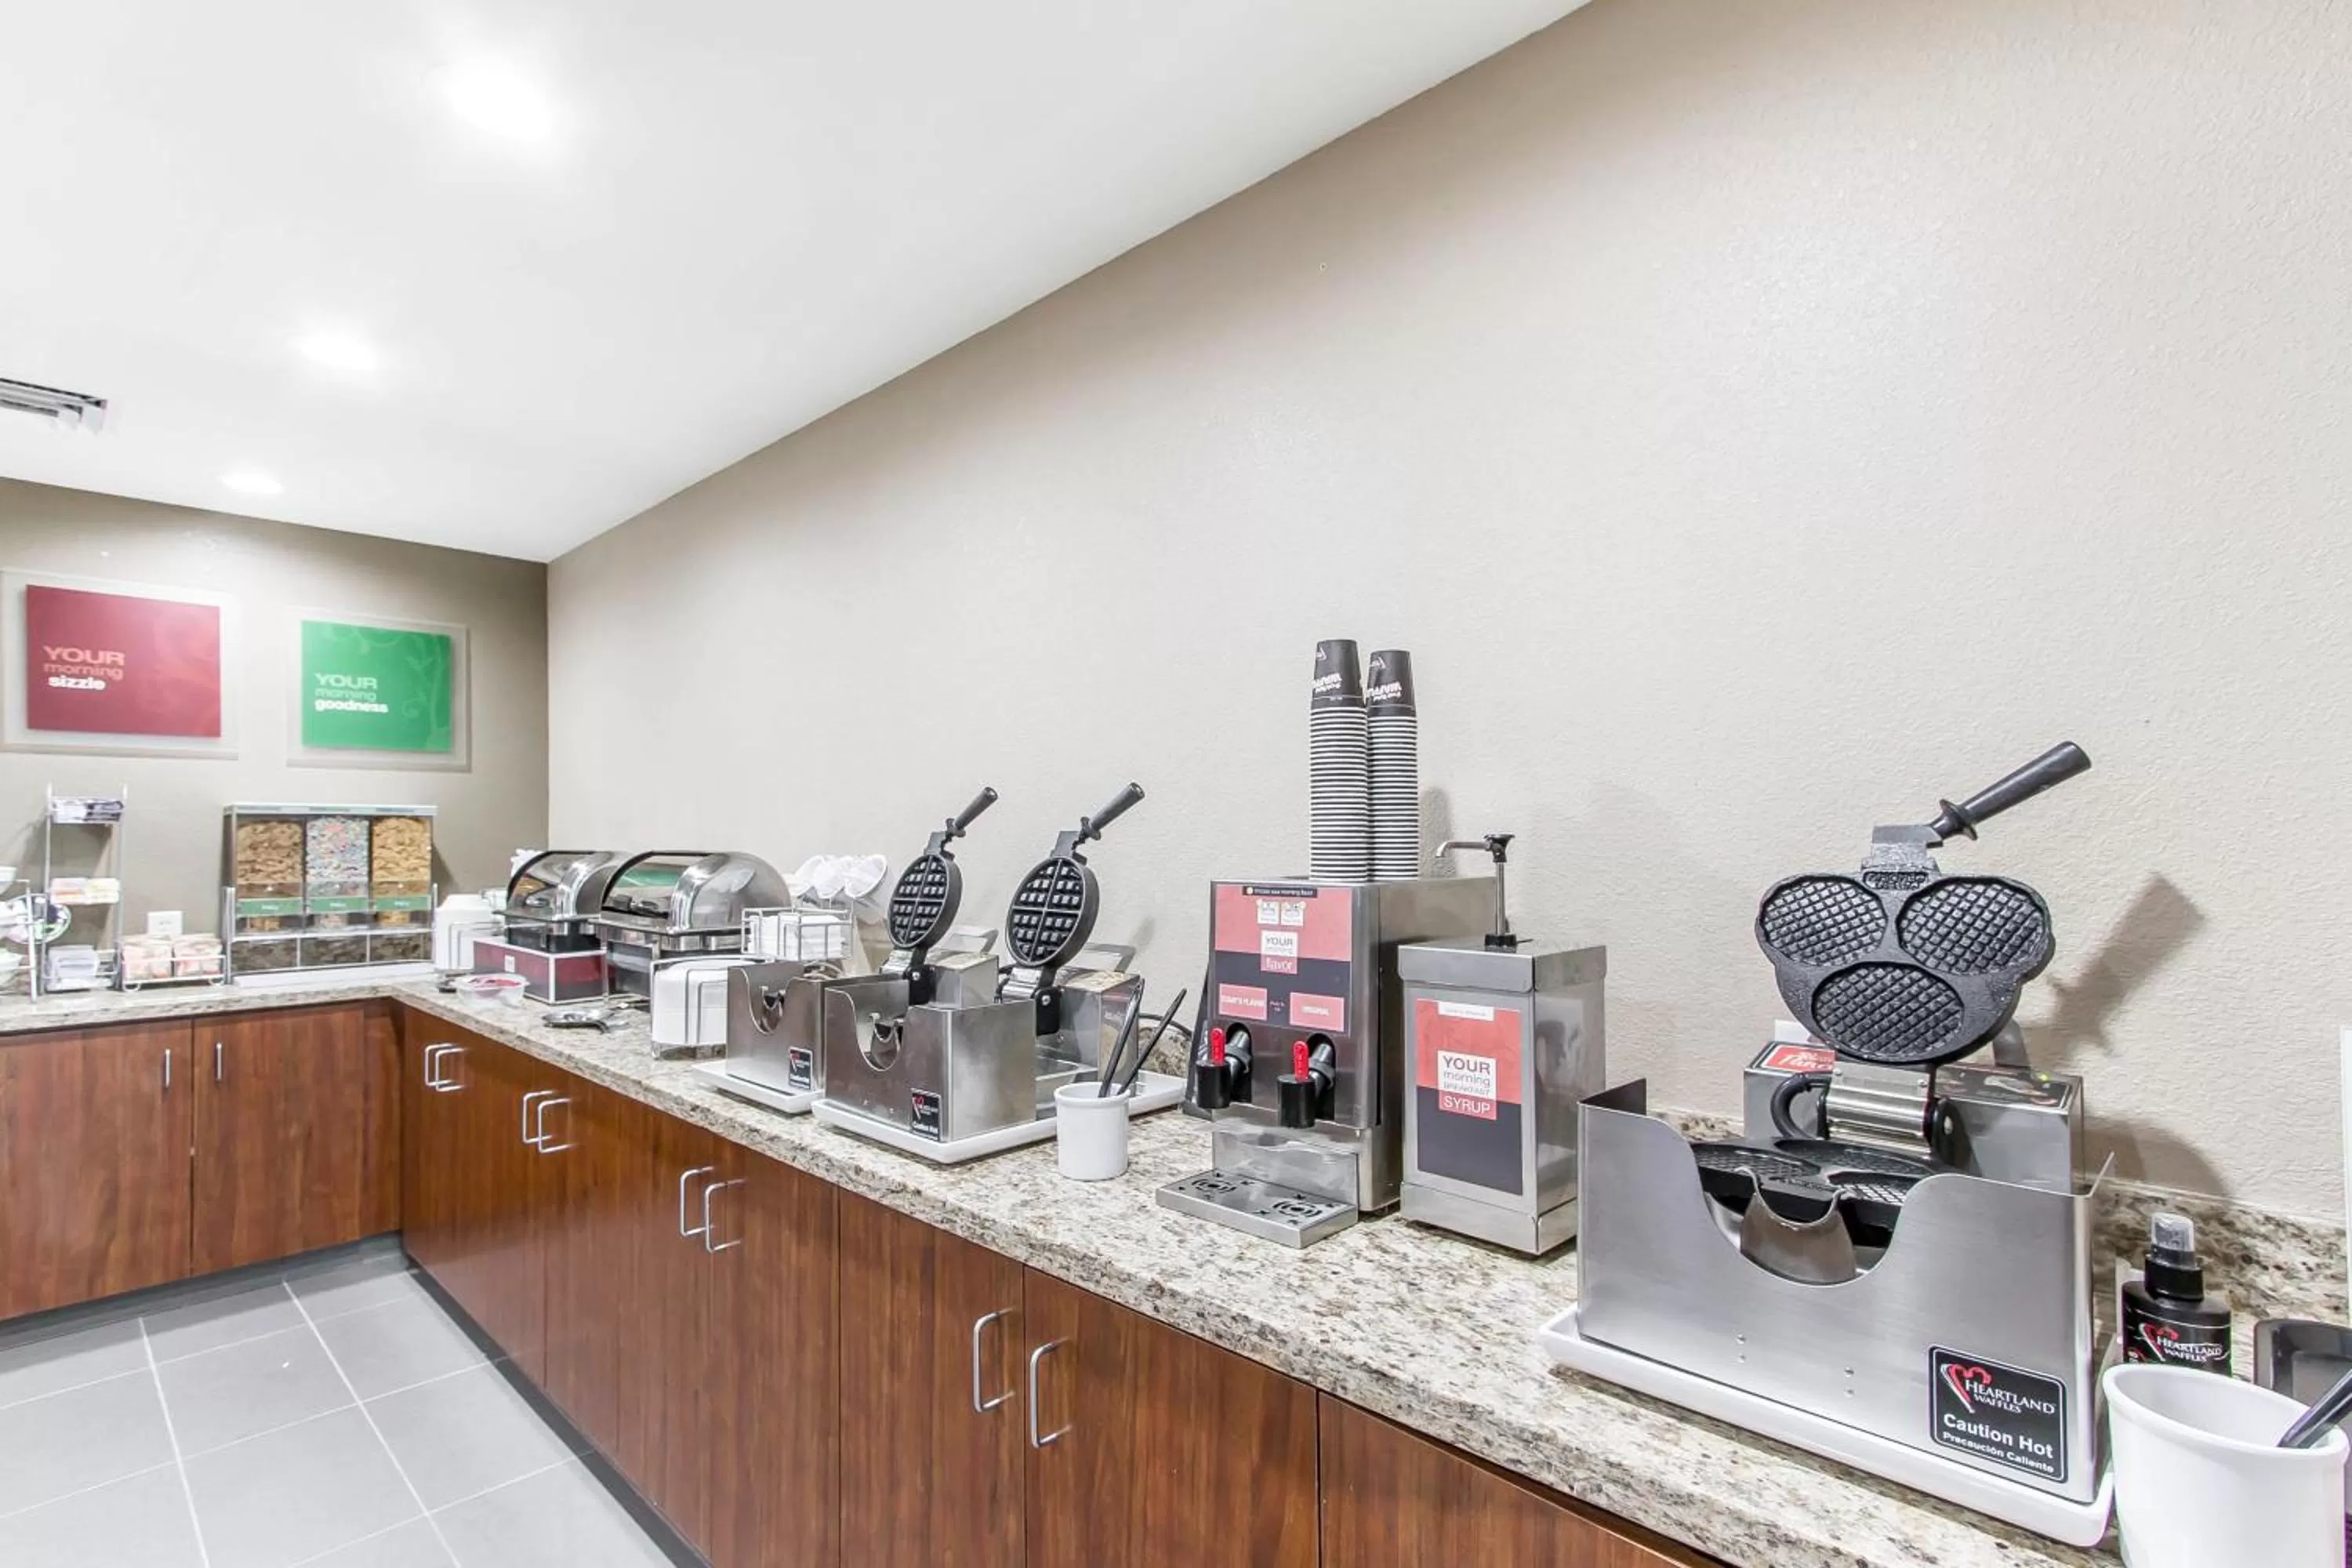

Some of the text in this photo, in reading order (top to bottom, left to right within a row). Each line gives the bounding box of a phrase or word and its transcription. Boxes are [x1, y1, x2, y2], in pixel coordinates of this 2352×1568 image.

[43, 645, 125, 666] YOUR
[43, 663, 124, 681] morning
[48, 674, 106, 691] sizzle
[314, 673, 378, 690] YOUR
[315, 688, 377, 702] morning
[314, 699, 390, 713] goodness
[1266, 936, 1293, 946] YOUR
[1443, 1054, 1491, 1075] YOUR
[1443, 1070, 1491, 1087] morning
[1443, 1095, 1490, 1114] SYRUP
[2157, 1335, 2223, 1357] HEARTLAND
[2163, 1348, 2207, 1363] WAFFLES
[1965, 1379, 2056, 1415] HEARTLAND
[1974, 1394, 2022, 1414] WAFFLES
[1944, 1413, 2053, 1459] Caution Hot
[1942, 1431, 2054, 1473] Precaución Caliente
